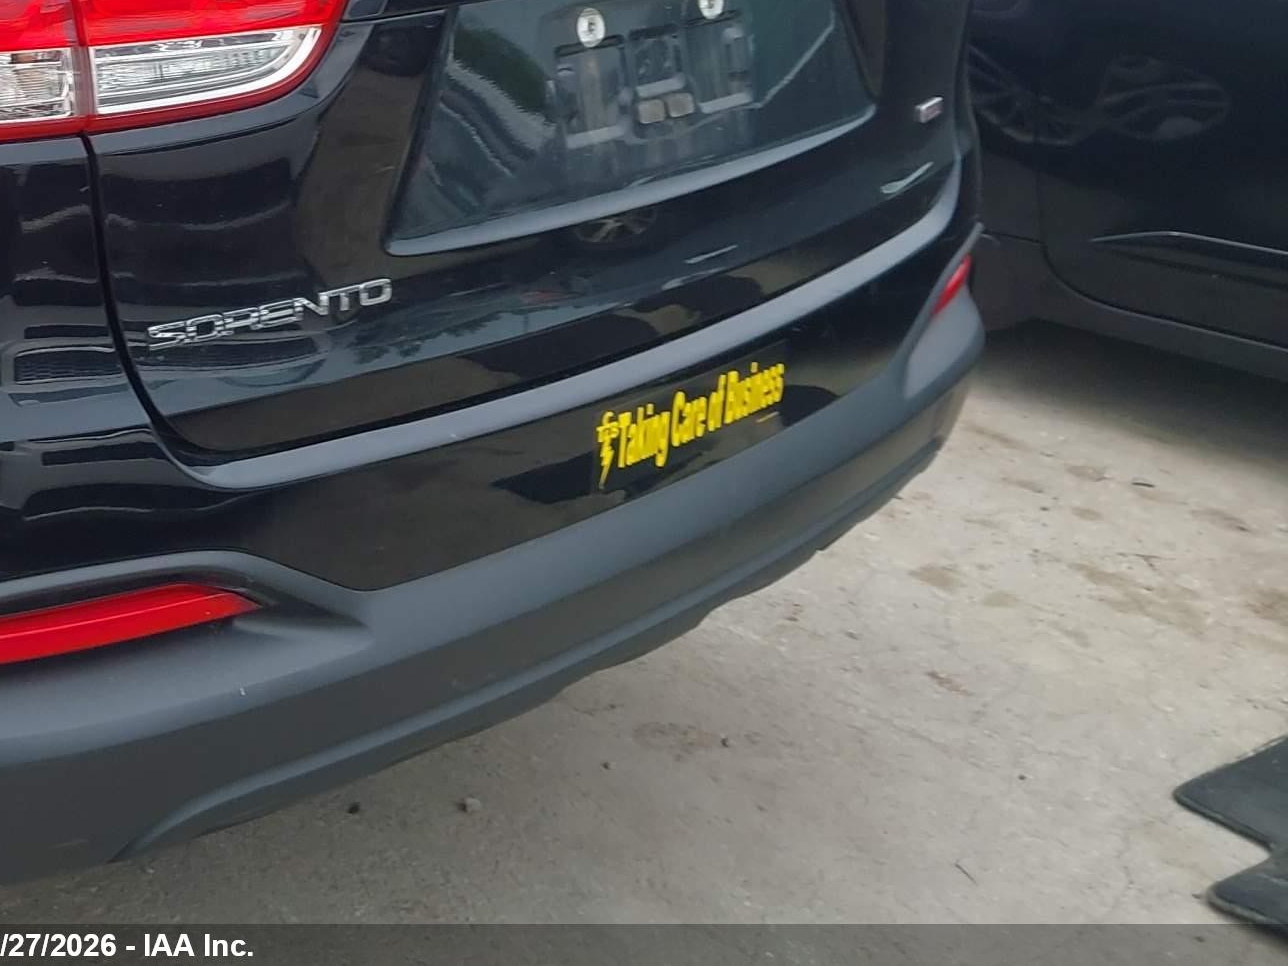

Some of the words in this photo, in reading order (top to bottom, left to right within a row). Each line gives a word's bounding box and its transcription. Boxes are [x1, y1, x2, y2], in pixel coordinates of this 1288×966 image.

[147, 278, 393, 351] SORENTO
[617, 403, 671, 468] Taking
[671, 391, 707, 447] Care
[707, 374, 727, 432] of
[723, 361, 785, 425] Business
